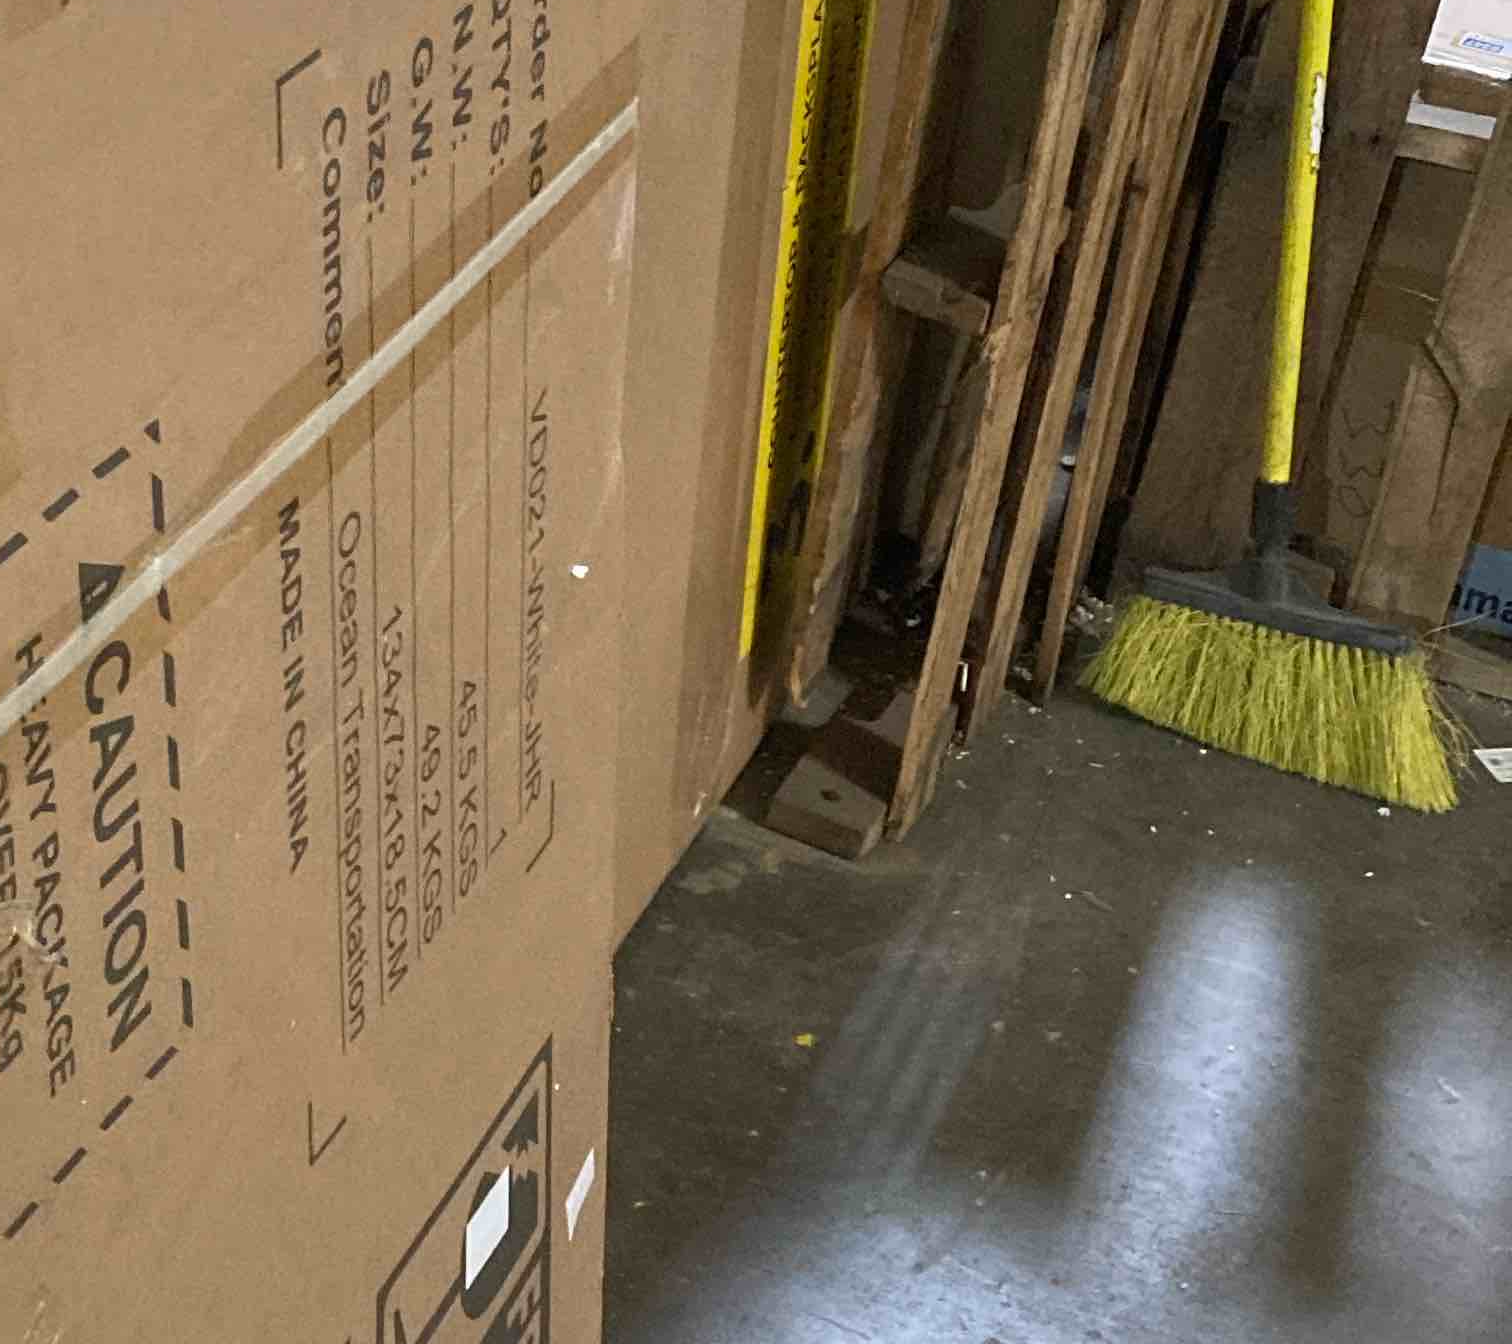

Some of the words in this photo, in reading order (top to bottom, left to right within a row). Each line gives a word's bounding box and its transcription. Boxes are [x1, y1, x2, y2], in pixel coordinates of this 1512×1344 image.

[365, 68, 393, 224] Size:
[277, 496, 304, 653] MADE
[338, 511, 361, 689] Ocean
[14, 631, 58, 822] HAVY
[283, 655, 305, 713] IN
[457, 680, 479, 781] 45.5
[85, 639, 154, 1054] CAUTION
[285, 719, 309, 876] CHINA
[421, 723, 441, 829] 49.2
[458, 785, 478, 897] KGS
[339, 687, 368, 1043] Transportation
[422, 830, 443, 944] KGS
[31, 831, 76, 1098] PACKAGE
